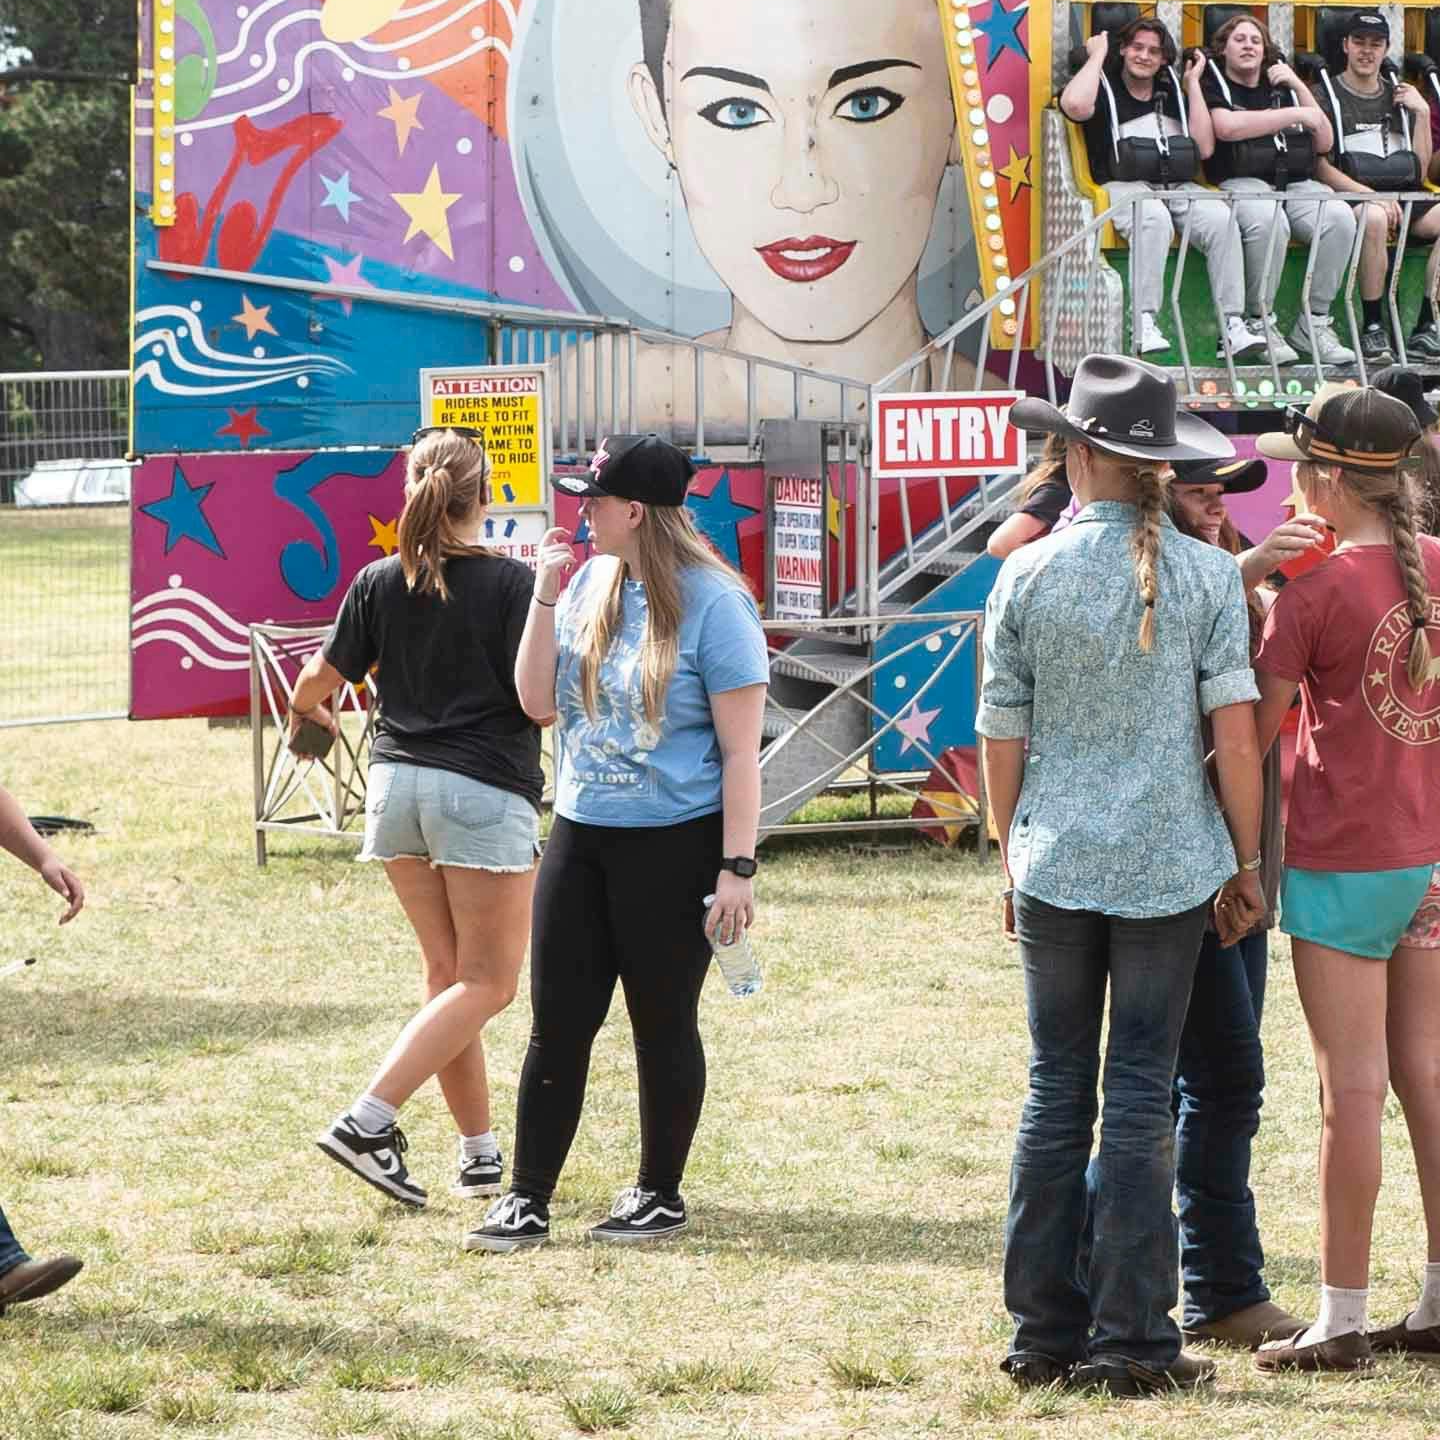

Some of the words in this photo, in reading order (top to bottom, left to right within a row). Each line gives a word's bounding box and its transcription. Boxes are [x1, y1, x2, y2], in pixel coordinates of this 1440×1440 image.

[433, 378, 537, 395] ATTENTION
[445, 397, 489, 409] RIDERS
[492, 396, 525, 408] MUST
[441, 412, 456, 424] BE
[460, 411, 490, 423] ABLE
[495, 410, 510, 422] TO
[513, 409, 529, 421] FIT
[491, 423, 535, 436] WITHIN
[885, 405, 1011, 462] ENTRY
[518, 437, 533, 450] TO
[509, 453, 537, 465] RIDE
